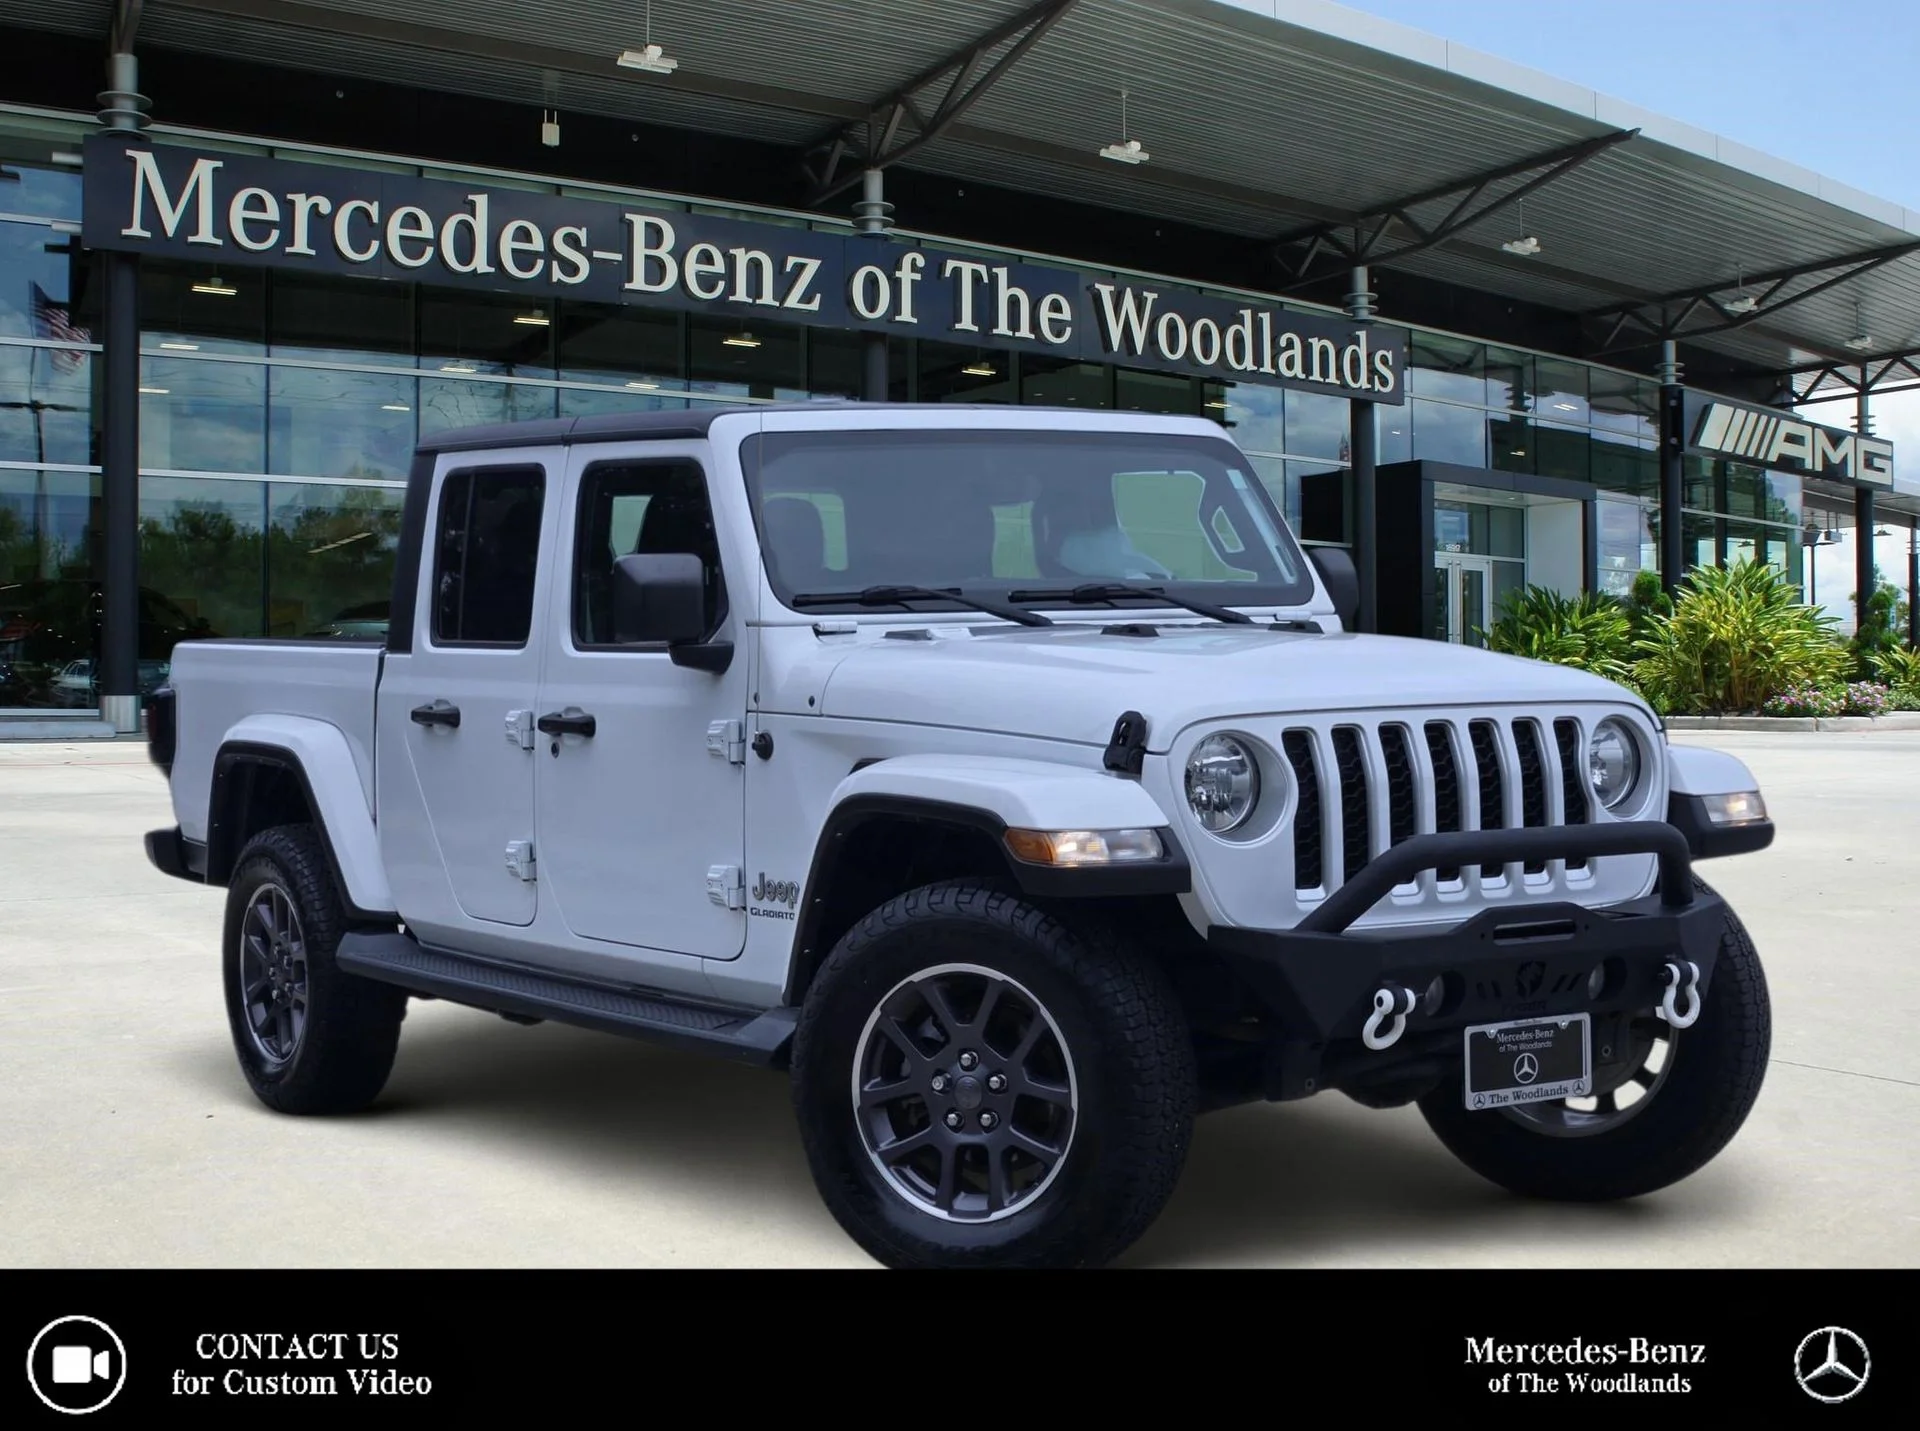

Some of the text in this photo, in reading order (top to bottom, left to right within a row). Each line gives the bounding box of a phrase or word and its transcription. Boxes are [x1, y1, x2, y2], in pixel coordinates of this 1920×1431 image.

[121, 149, 1395, 394] Mercedes-Benz of The Woodlands
[1767, 419, 1892, 486] AMG
[752, 871, 800, 910] Jeep
[750, 907, 796, 921] GLADIATO
[1497, 1029, 1553, 1043] Mercedes-Benz
[1519, 1040, 1552, 1050] Woodlands
[1489, 1085, 1569, 1104] The Woodlands
